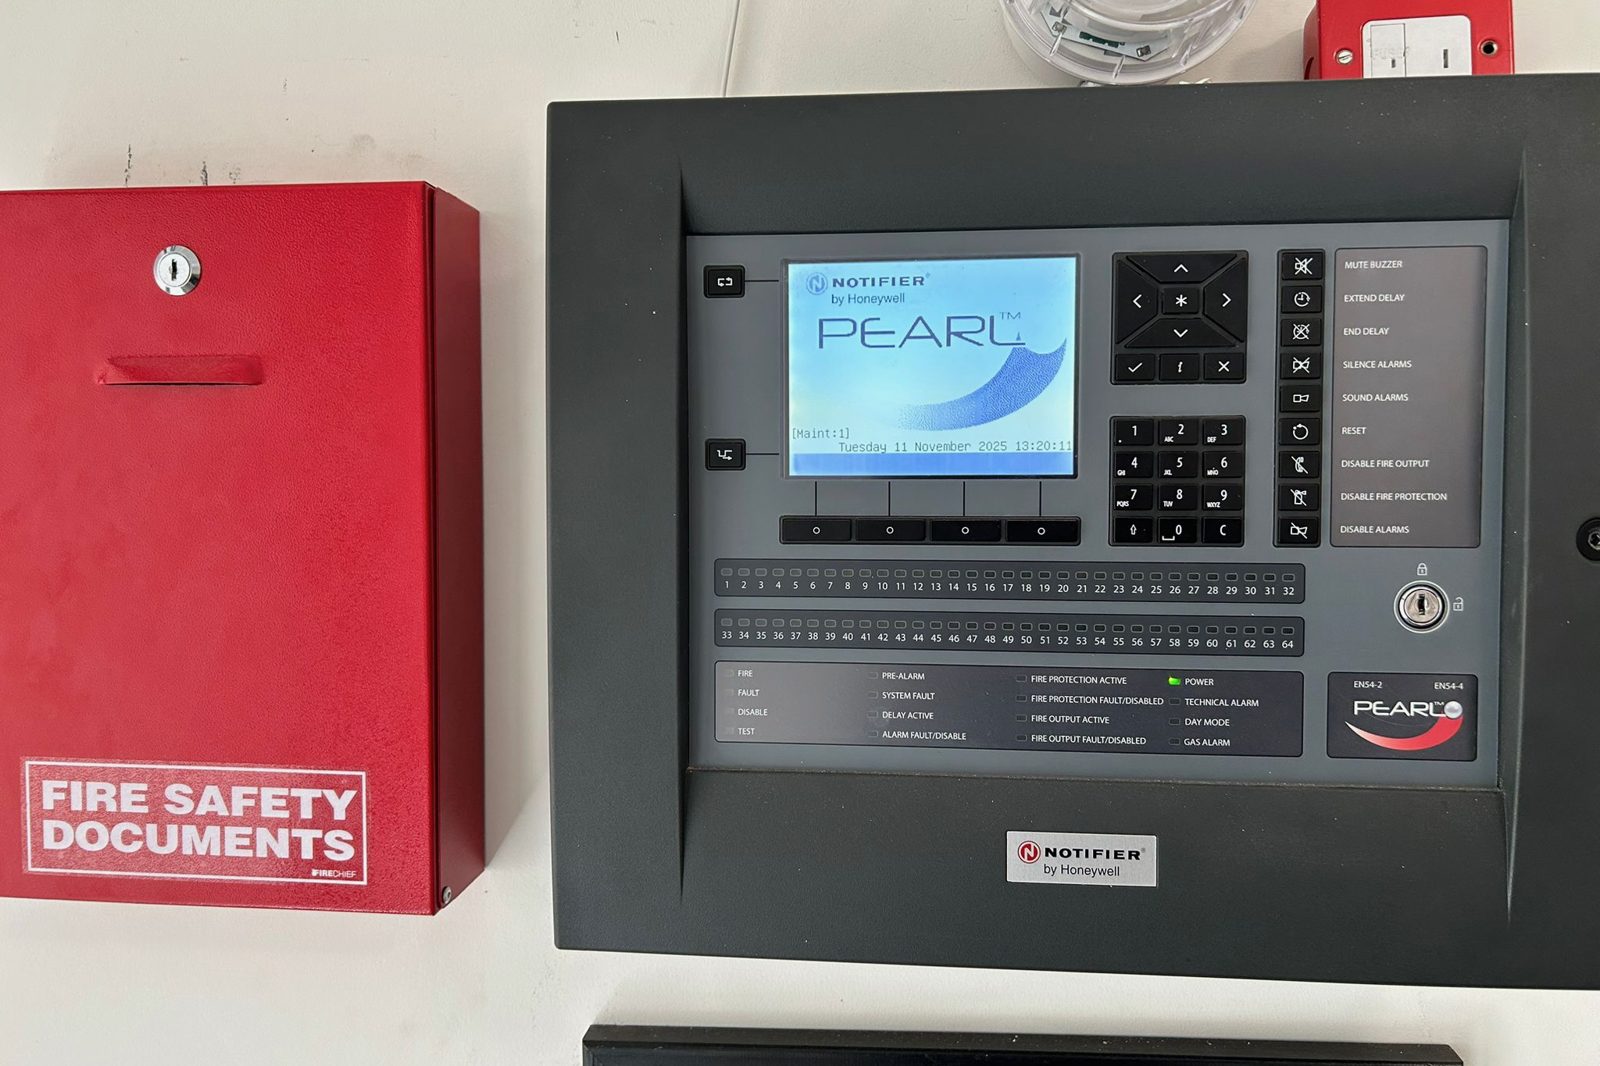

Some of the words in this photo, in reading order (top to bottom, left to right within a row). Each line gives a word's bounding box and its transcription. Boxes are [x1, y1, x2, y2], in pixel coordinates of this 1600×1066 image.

[1345, 261, 1368, 270] MUTE
[1370, 260, 1402, 269] BUZZER
[832, 277, 925, 288] NOTIFIER
[831, 294, 844, 305] by
[848, 293, 905, 304] Honeywell
[1344, 294, 1377, 303] EXTEND
[1378, 294, 1406, 302] DELAY
[818, 316, 1026, 348] PEARL
[1344, 328, 1361, 336] END
[1363, 328, 1389, 336] DELAY
[1343, 361, 1376, 369] SILENCE
[1378, 360, 1412, 369] ALARMS
[1342, 394, 1372, 402] SOUND
[1374, 394, 1409, 402] ALARMS
[792, 428, 849, 439] [Maint:1]
[1132, 425, 1137, 436] 1
[1177, 424, 1184, 435] 2
[1221, 424, 1228, 435] 3
[1342, 427, 1366, 435] RESET
[839, 442, 886, 453] Tuesday
[895, 442, 907, 452] 11
[915, 442, 971, 452] November
[978, 441, 1007, 451] 2025
[1015, 441, 1072, 451] 13:20:11
[1131, 457, 1138, 468] 4
[1176, 457, 1183, 468] 5
[1221, 456, 1227, 468] 6
[1341, 460, 1375, 468] DISABLE
[1377, 460, 1393, 468] FIRE
[1395, 460, 1429, 468] OUTPUT
[1130, 489, 1137, 500] 7
[1176, 489, 1183, 500] 8
[1220, 490, 1227, 500] 9
[1341, 493, 1375, 501] DISABLE
[1376, 493, 1393, 501] FIRE
[1395, 493, 1447, 501] PROTECTION
[1220, 525, 1226, 536] C
[1340, 526, 1374, 534] DISABLE
[1375, 526, 1409, 534] ALARMS
[725, 581, 729, 589] 1
[741, 581, 747, 589] 2
[758, 581, 764, 590] 3
[775, 581, 782, 589] 4
[793, 581, 799, 590] 5
[809, 582, 817, 590] 6
[827, 582, 834, 590] 7
[844, 582, 851, 590] 8
[862, 582, 869, 591] 9
[878, 582, 889, 591] 10
[897, 583, 906, 591] 11
[914, 583, 924, 591] 12
[931, 583, 942, 591] 13
[949, 583, 960, 591] 14
[967, 583, 978, 592] 15
[985, 584, 996, 592] 16
[1003, 584, 1014, 592] 17
[1022, 584, 1032, 593] 18
[1040, 584, 1051, 593] 19
[1058, 584, 1070, 593] 20
[1077, 585, 1087, 593] 21
[1095, 585, 1106, 594] 22
[1114, 585, 1125, 594] 23
[1132, 585, 1144, 594] 24
[1151, 586, 1163, 594] 25
[1169, 586, 1182, 595] 26
[1188, 586, 1200, 595] 27
[1207, 586, 1219, 595] 28
[1226, 586, 1238, 595] 29
[1245, 587, 1257, 596] 30
[1265, 587, 1275, 596] 31
[1283, 587, 1295, 596] 32
[722, 631, 733, 640] 33
[739, 631, 750, 640] 34
[757, 632, 767, 640] 35
[774, 632, 785, 640] 36
[791, 632, 802, 641] 37
[808, 632, 819, 641] 38
[825, 632, 836, 641] 39
[843, 633, 854, 641] 40
[861, 633, 871, 641] 41
[878, 633, 889, 642] 42
[895, 634, 907, 642] 43
[913, 634, 924, 642] 44
[931, 634, 942, 643] 45
[949, 635, 960, 643] 46
[967, 635, 978, 643] 47
[985, 635, 996, 644] 48
[1003, 636, 1015, 644] 49
[1021, 636, 1033, 645] 50
[1040, 636, 1050, 645] 51
[1058, 636, 1069, 645] 52
[1076, 637, 1088, 646] 53
[1095, 637, 1106, 646] 54
[1113, 638, 1125, 646] 55
[1132, 638, 1144, 647] 56
[1151, 638, 1162, 647] 57
[1169, 639, 1181, 647] 58
[1188, 639, 1200, 648] 59
[1207, 639, 1219, 648] 60
[1226, 640, 1237, 648] 61
[1244, 640, 1256, 649] 62
[1263, 640, 1275, 649] 63
[1282, 640, 1294, 649] 64
[738, 670, 752, 678] FIRE
[882, 672, 925, 680] PRE-ALARM
[1031, 675, 1047, 684] FIRE
[1049, 676, 1097, 684] PROTECTION
[1100, 677, 1127, 685] ACTIVE
[1185, 678, 1214, 686] POWER
[738, 689, 759, 697] FAULT
[882, 692, 911, 700] SYSTEM
[913, 692, 935, 701] FAULT
[1031, 695, 1047, 703] FIRE
[1049, 695, 1097, 704] PROTECTION
[1100, 697, 1164, 706] FAULT/DISABLED
[1185, 698, 1229, 707] TECHNICAL
[1231, 699, 1259, 707] ALARM
[738, 708, 767, 717] DISABLE
[1354, 701, 1446, 718] PEARL
[882, 711, 906, 719] DELAY
[907, 712, 933, 720] ACTIVE
[1032, 715, 1047, 723] FIRE
[1049, 715, 1080, 724] OUTPUT
[1082, 716, 1109, 725] ACTIVE
[1185, 718, 1202, 726] DAY
[1204, 719, 1230, 727] MODE
[738, 728, 755, 736] TEST
[882, 731, 909, 739] ALARM
[911, 732, 966, 741] FAULT/DISABLE
[1032, 735, 1047, 743] FIRE
[1049, 735, 1081, 744] OUTPUT
[1083, 736, 1146, 745] FAULT/DISABLED
[1184, 738, 1201, 747] GAS
[1202, 739, 1230, 747] ALARM
[41, 780, 149, 814] FIRE
[164, 783, 357, 821] SAFETY
[43, 819, 355, 861] DOCUMENTS
[1045, 847, 1140, 860] NOTIFIER
[1044, 864, 1057, 876] by
[1061, 864, 1120, 878] Honeywell
